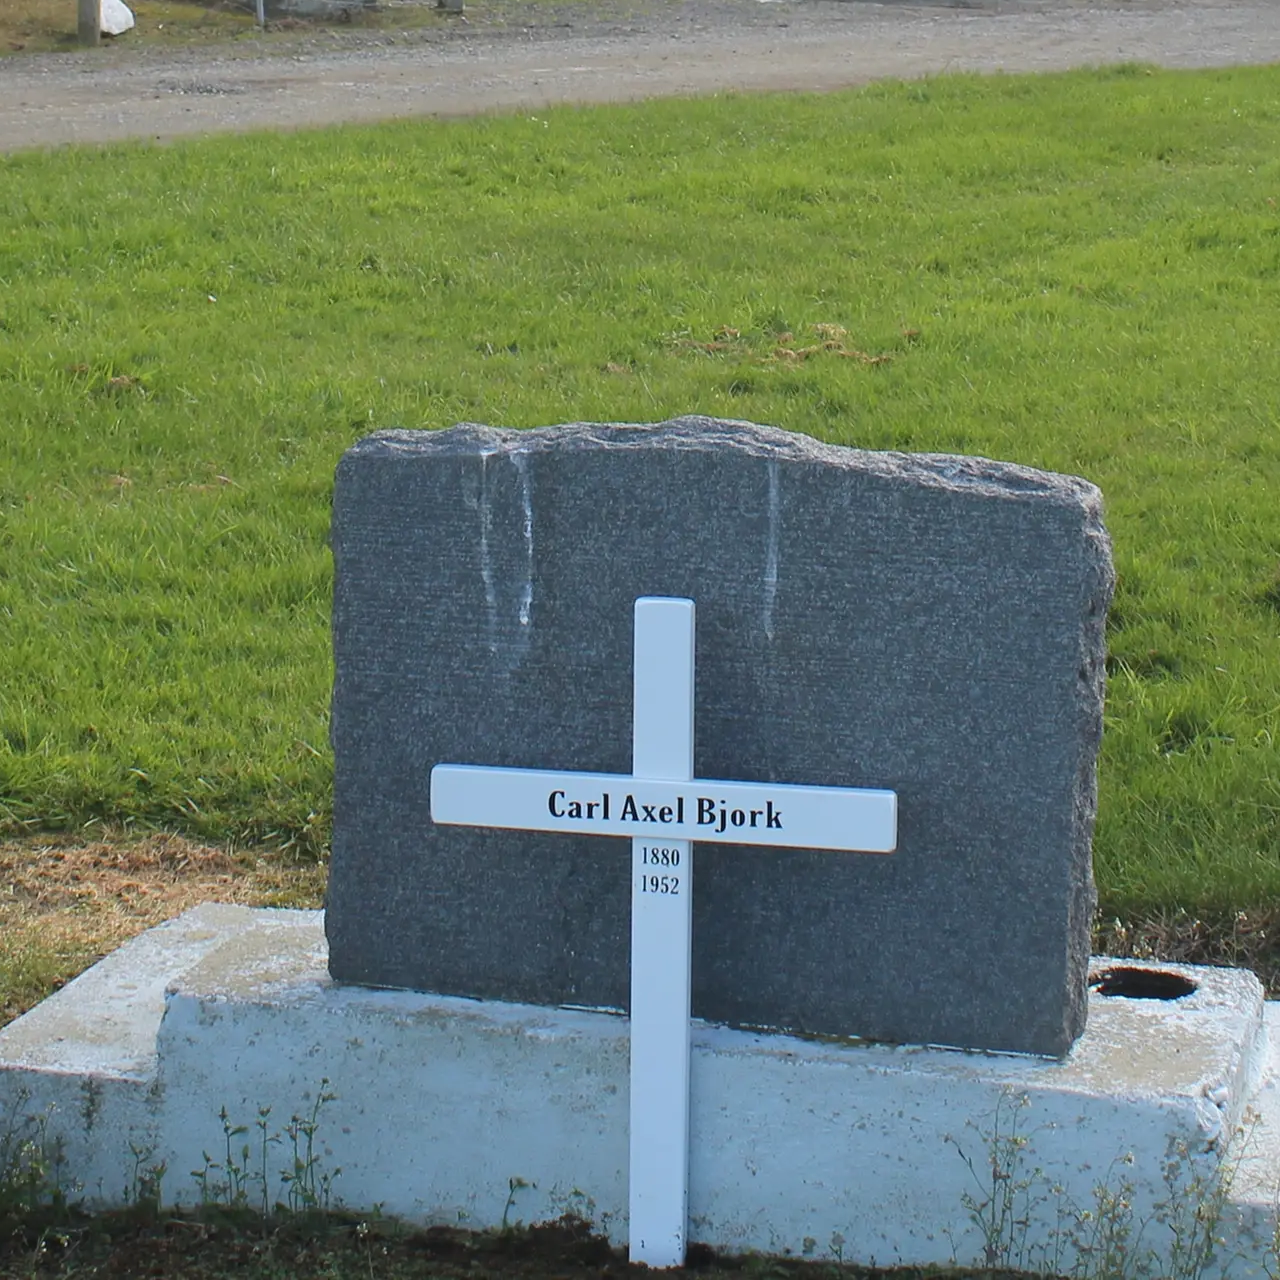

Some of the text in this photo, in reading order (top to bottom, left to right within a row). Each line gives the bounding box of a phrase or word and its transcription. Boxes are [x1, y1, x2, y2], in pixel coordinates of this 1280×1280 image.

[548, 790, 783, 833] Carl Axel Bjork
[642, 846, 680, 867] 1880
[642, 874, 680, 895] 1952
